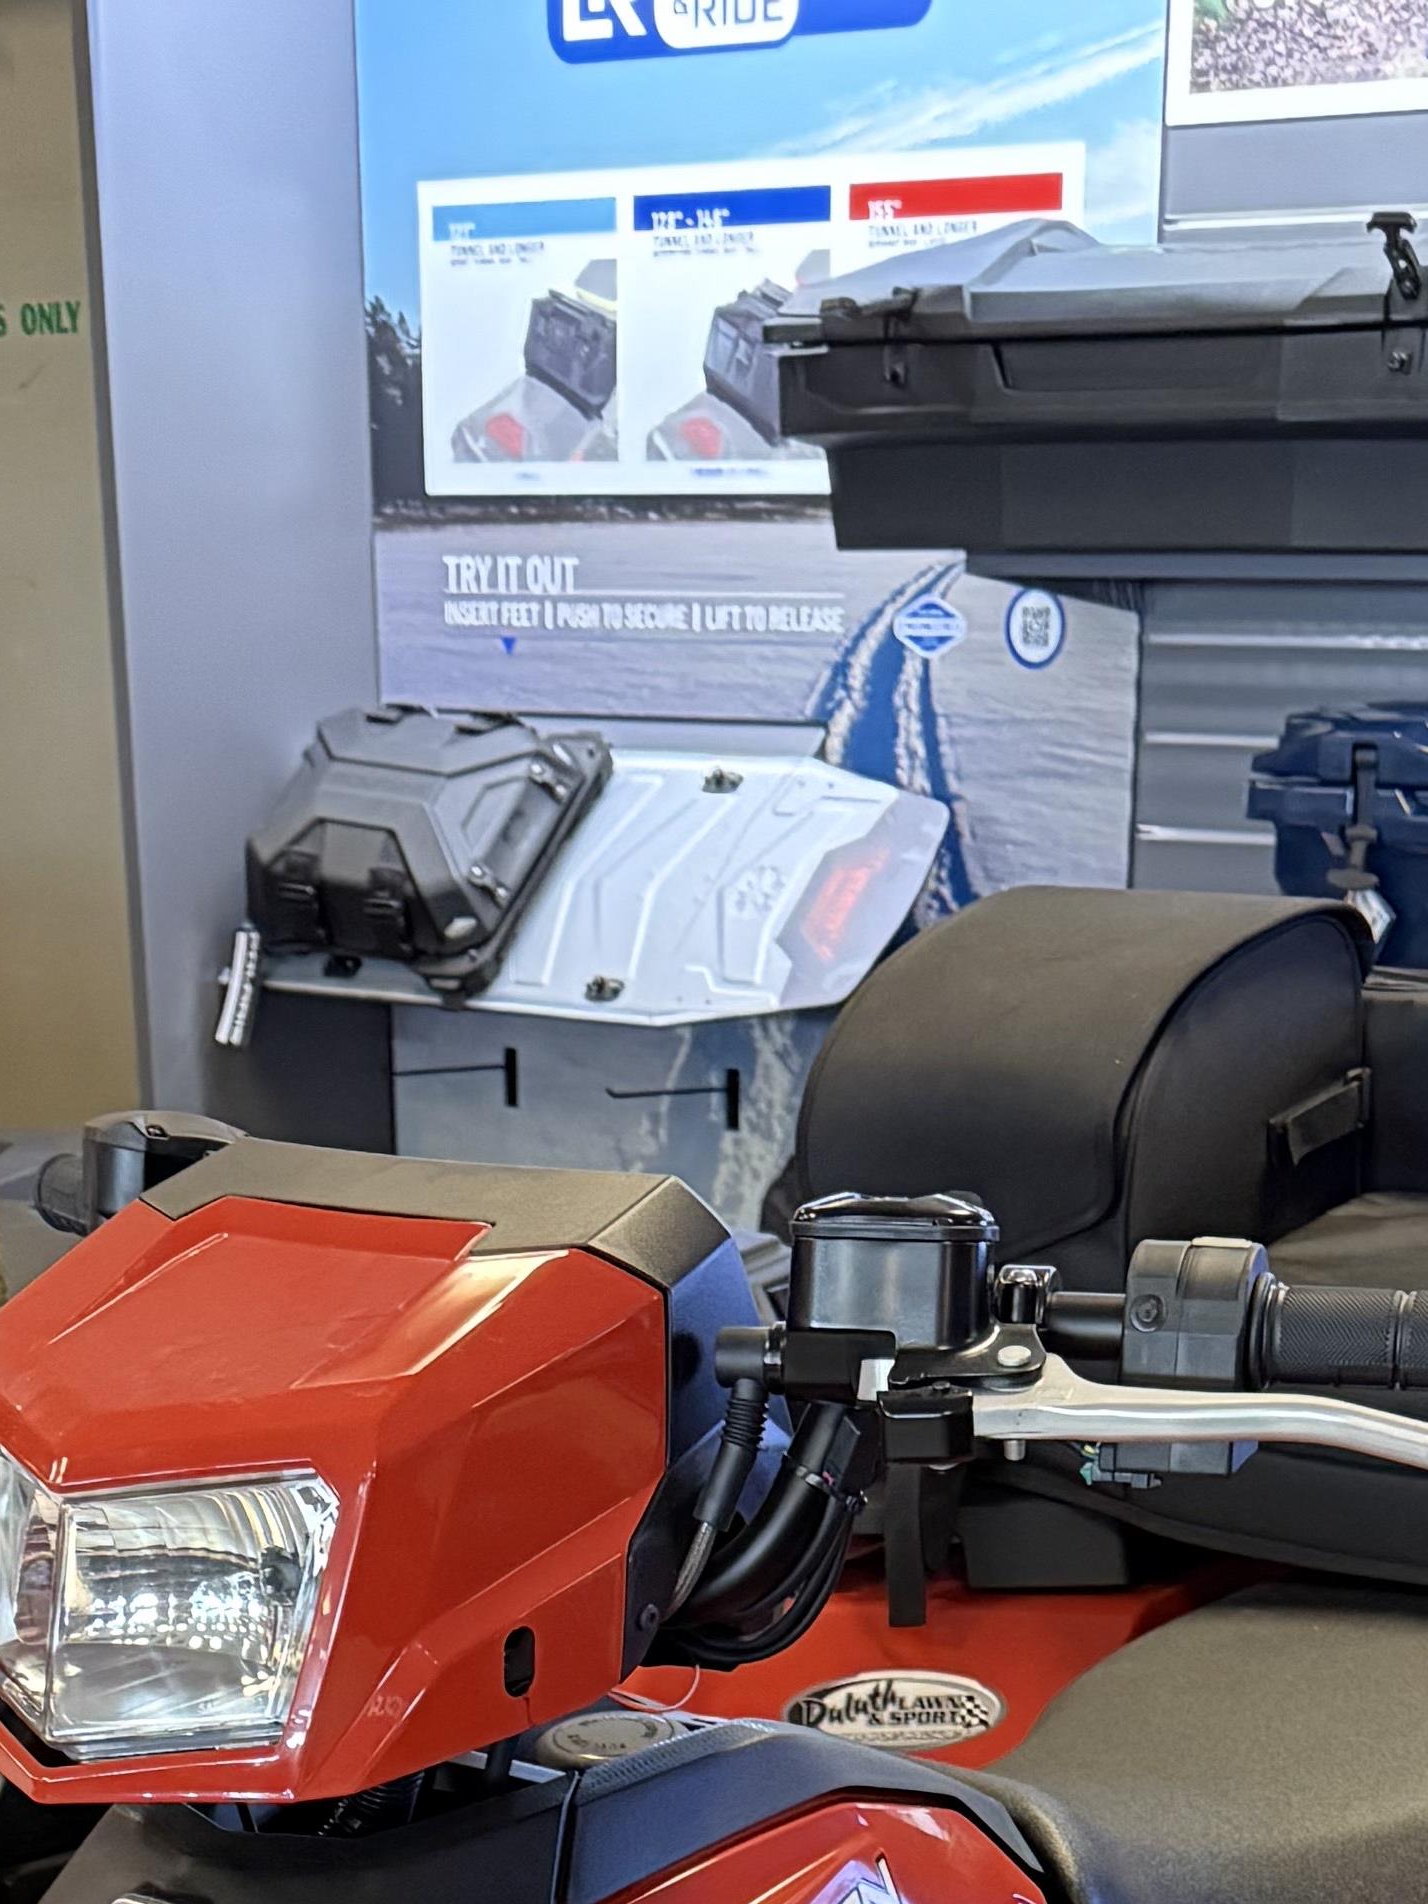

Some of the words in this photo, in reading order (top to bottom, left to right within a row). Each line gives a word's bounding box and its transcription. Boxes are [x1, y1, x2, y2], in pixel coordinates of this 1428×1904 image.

[20, 301, 81, 335] ONLY
[442, 555, 489, 594] TRY
[497, 556, 521, 594] IT
[526, 556, 579, 594] OUT
[806, 1679, 896, 1727] Duluth
